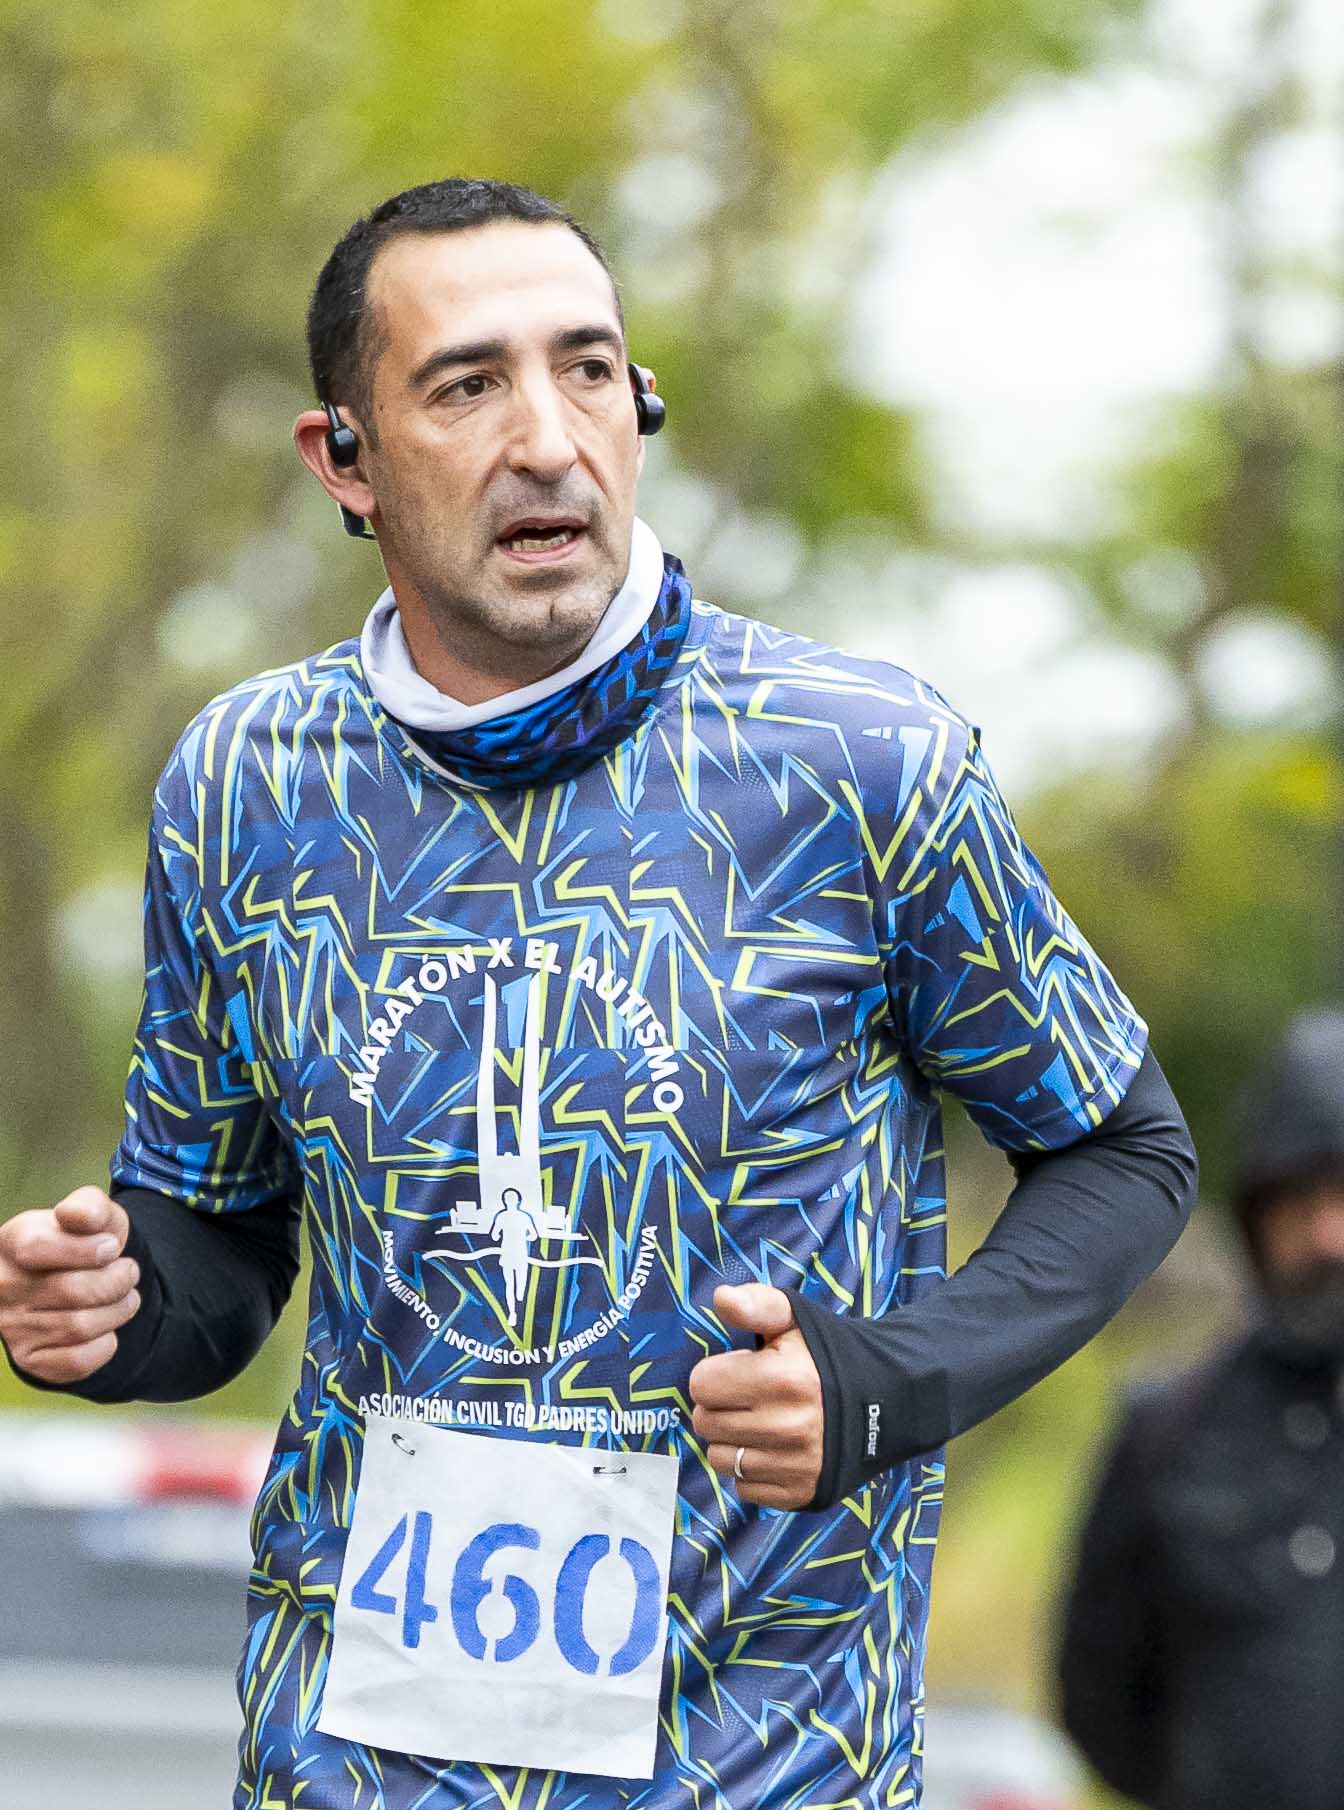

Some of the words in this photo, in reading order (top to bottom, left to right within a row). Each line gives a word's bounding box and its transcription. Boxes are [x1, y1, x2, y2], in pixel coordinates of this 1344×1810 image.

[349, 944, 476, 1107] MARATÓN
[487, 937, 514, 968] X
[524, 938, 562, 975] EL
[569, 956, 684, 1113] AUTISMO
[382, 1231, 440, 1337] MOVIMIENTO,
[542, 1346, 555, 1364] Y
[558, 1307, 625, 1358] ENERGÍA
[620, 1225, 658, 1312] POSITIVA
[358, 1391, 453, 1424] ASOCIACIÓN
[456, 1401, 503, 1426] CIVIL
[505, 1402, 536, 1428] TGD
[538, 1404, 607, 1433] PADRES
[610, 1408, 681, 1435] UNIDOS
[350, 1510, 661, 1677] 460
